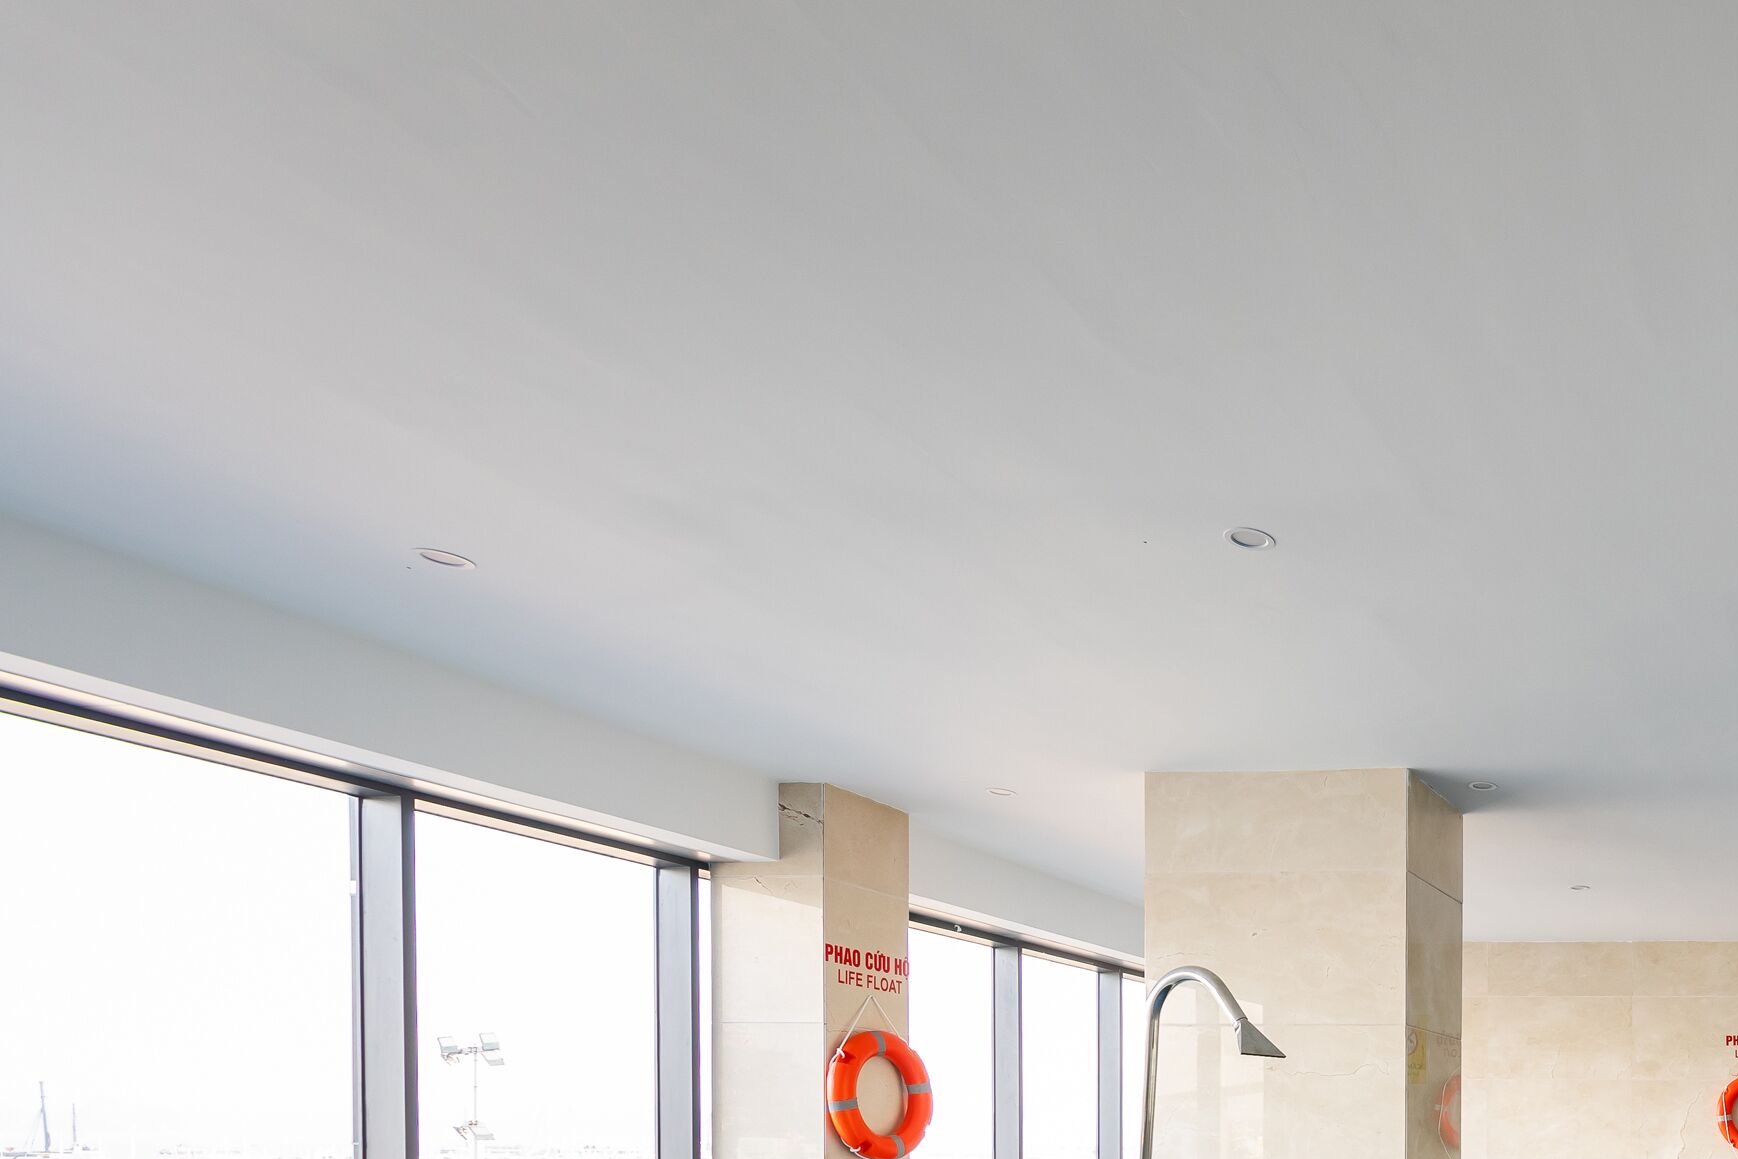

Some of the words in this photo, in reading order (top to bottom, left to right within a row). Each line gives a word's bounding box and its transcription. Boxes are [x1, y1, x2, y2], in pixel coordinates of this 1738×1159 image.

[825, 943, 861, 967] PHAO
[865, 951, 891, 973] CỨU
[838, 969, 863, 987] LIFE
[866, 975, 902, 994] FLOAT
